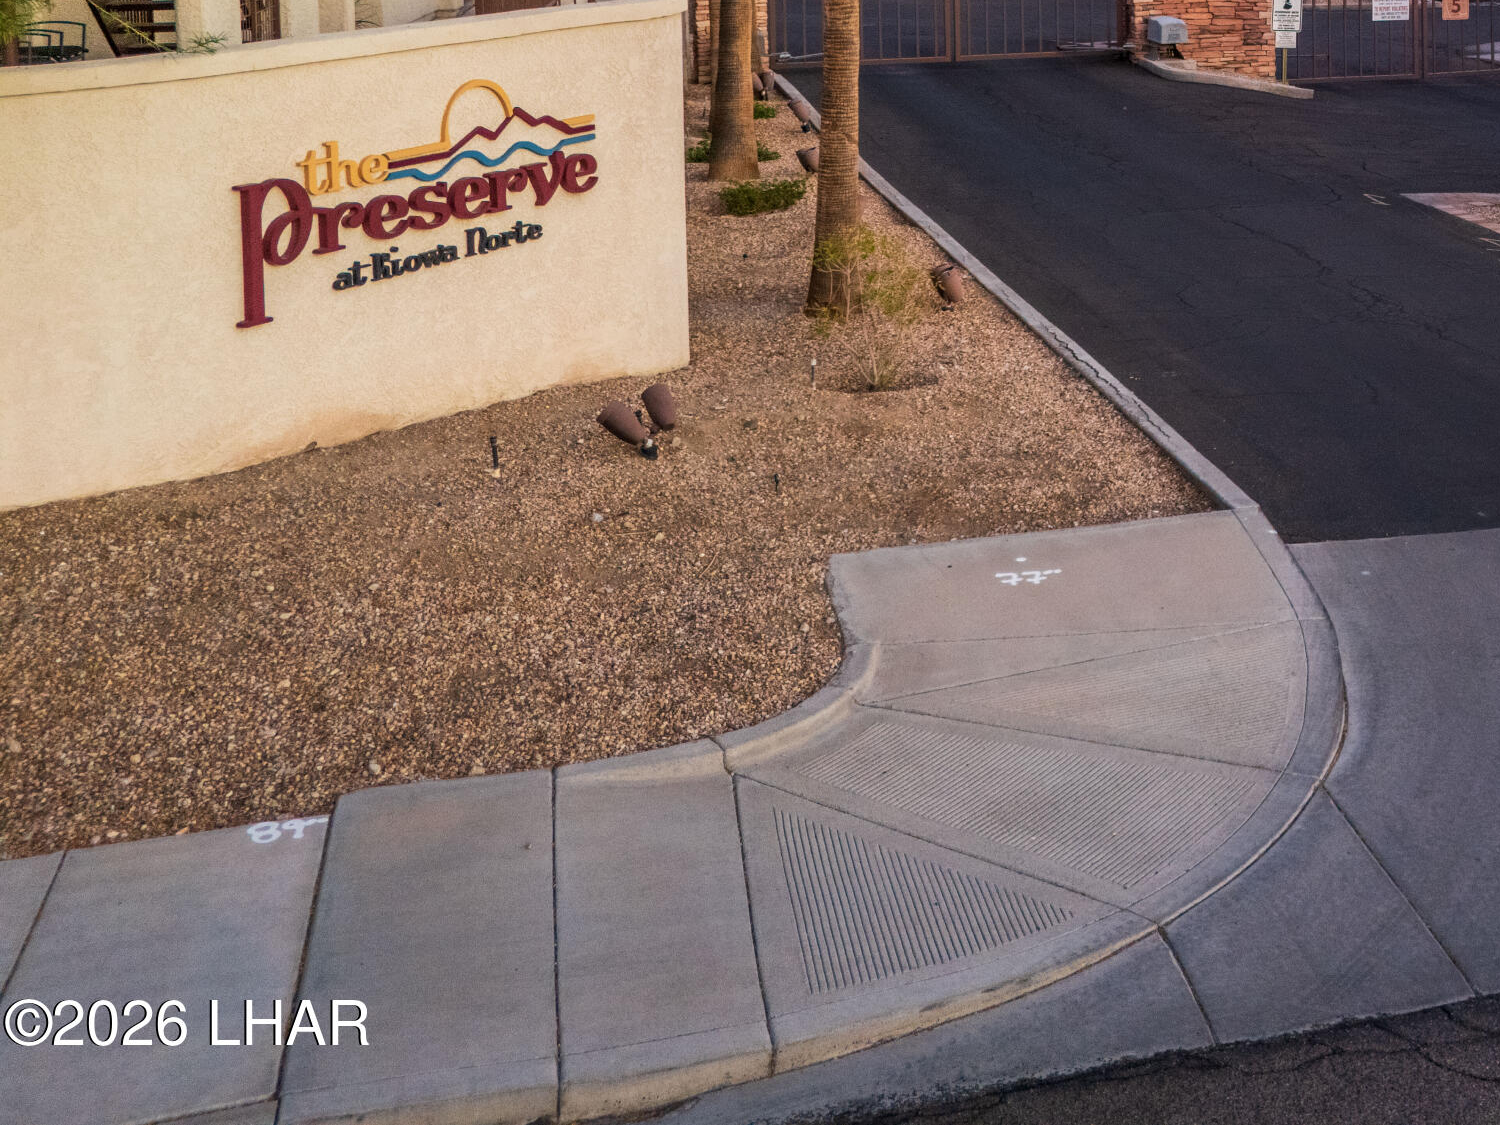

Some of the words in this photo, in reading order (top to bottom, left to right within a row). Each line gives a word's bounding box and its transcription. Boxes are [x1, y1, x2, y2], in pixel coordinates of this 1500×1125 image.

[296, 141, 390, 196] the
[332, 260, 372, 291] at
[370, 246, 460, 283] Kiowa
[463, 220, 544, 258] Norte
